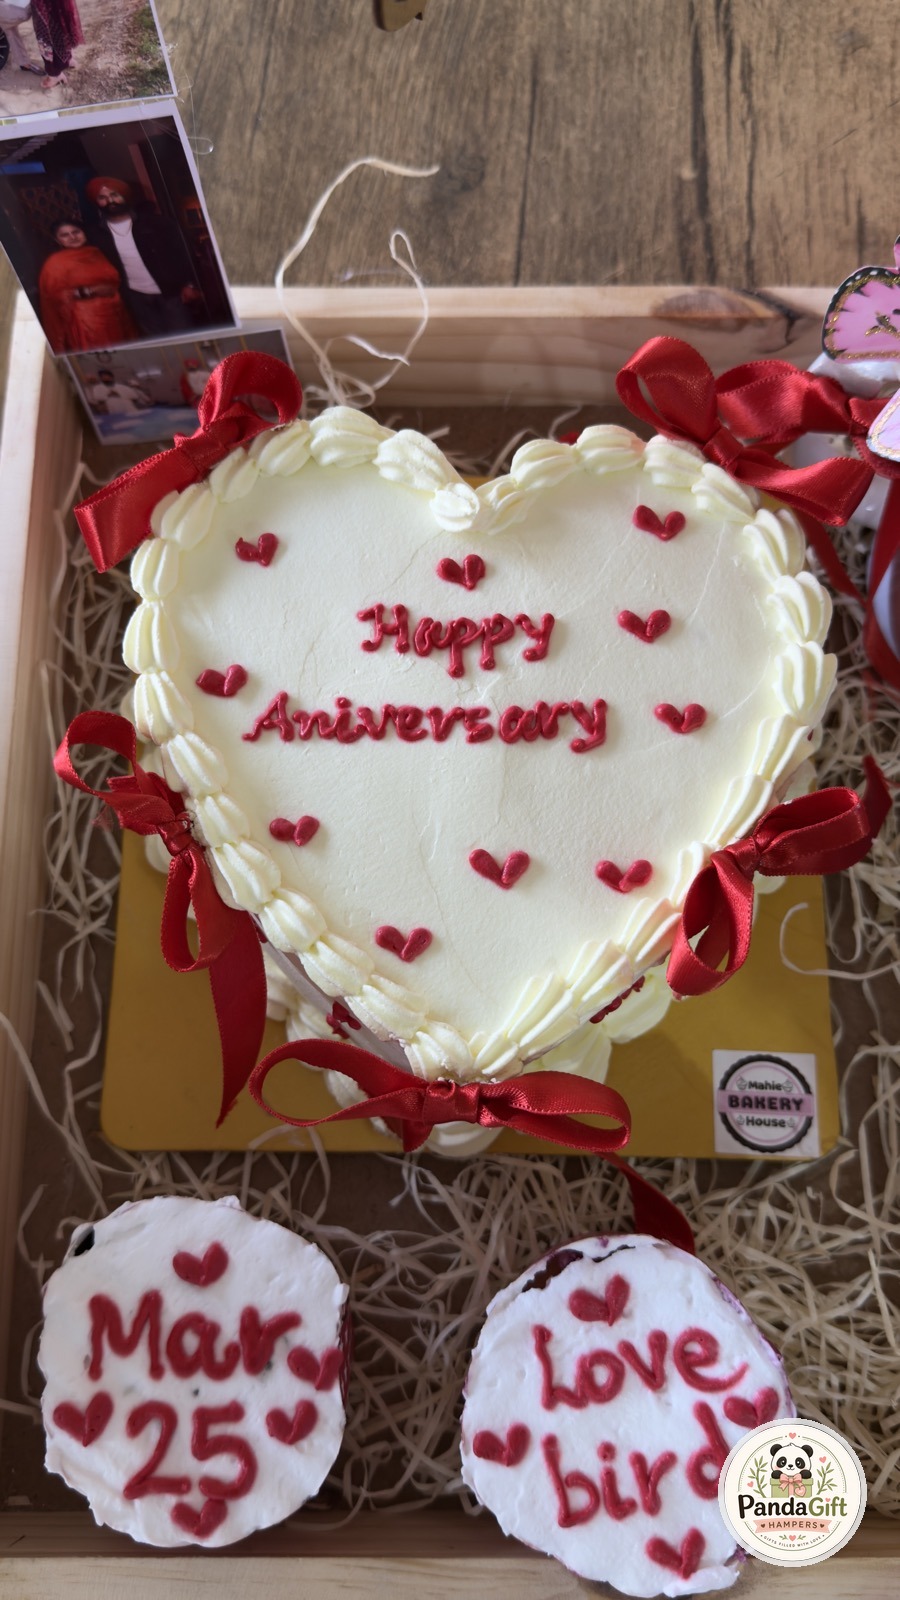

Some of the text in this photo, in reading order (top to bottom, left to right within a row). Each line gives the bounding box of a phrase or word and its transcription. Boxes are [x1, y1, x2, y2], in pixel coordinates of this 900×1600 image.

[356, 603, 556, 678] Happy
[242, 691, 608, 753] Aniversary
[728, 1095, 803, 1111] BAKERY
[746, 1116, 786, 1127] House
[748, 1081, 783, 1091] Mahie
[88, 1289, 302, 1382] Mar
[532, 1324, 749, 1411] Love
[123, 1400, 258, 1500] 25
[542, 1400, 731, 1528] bird
